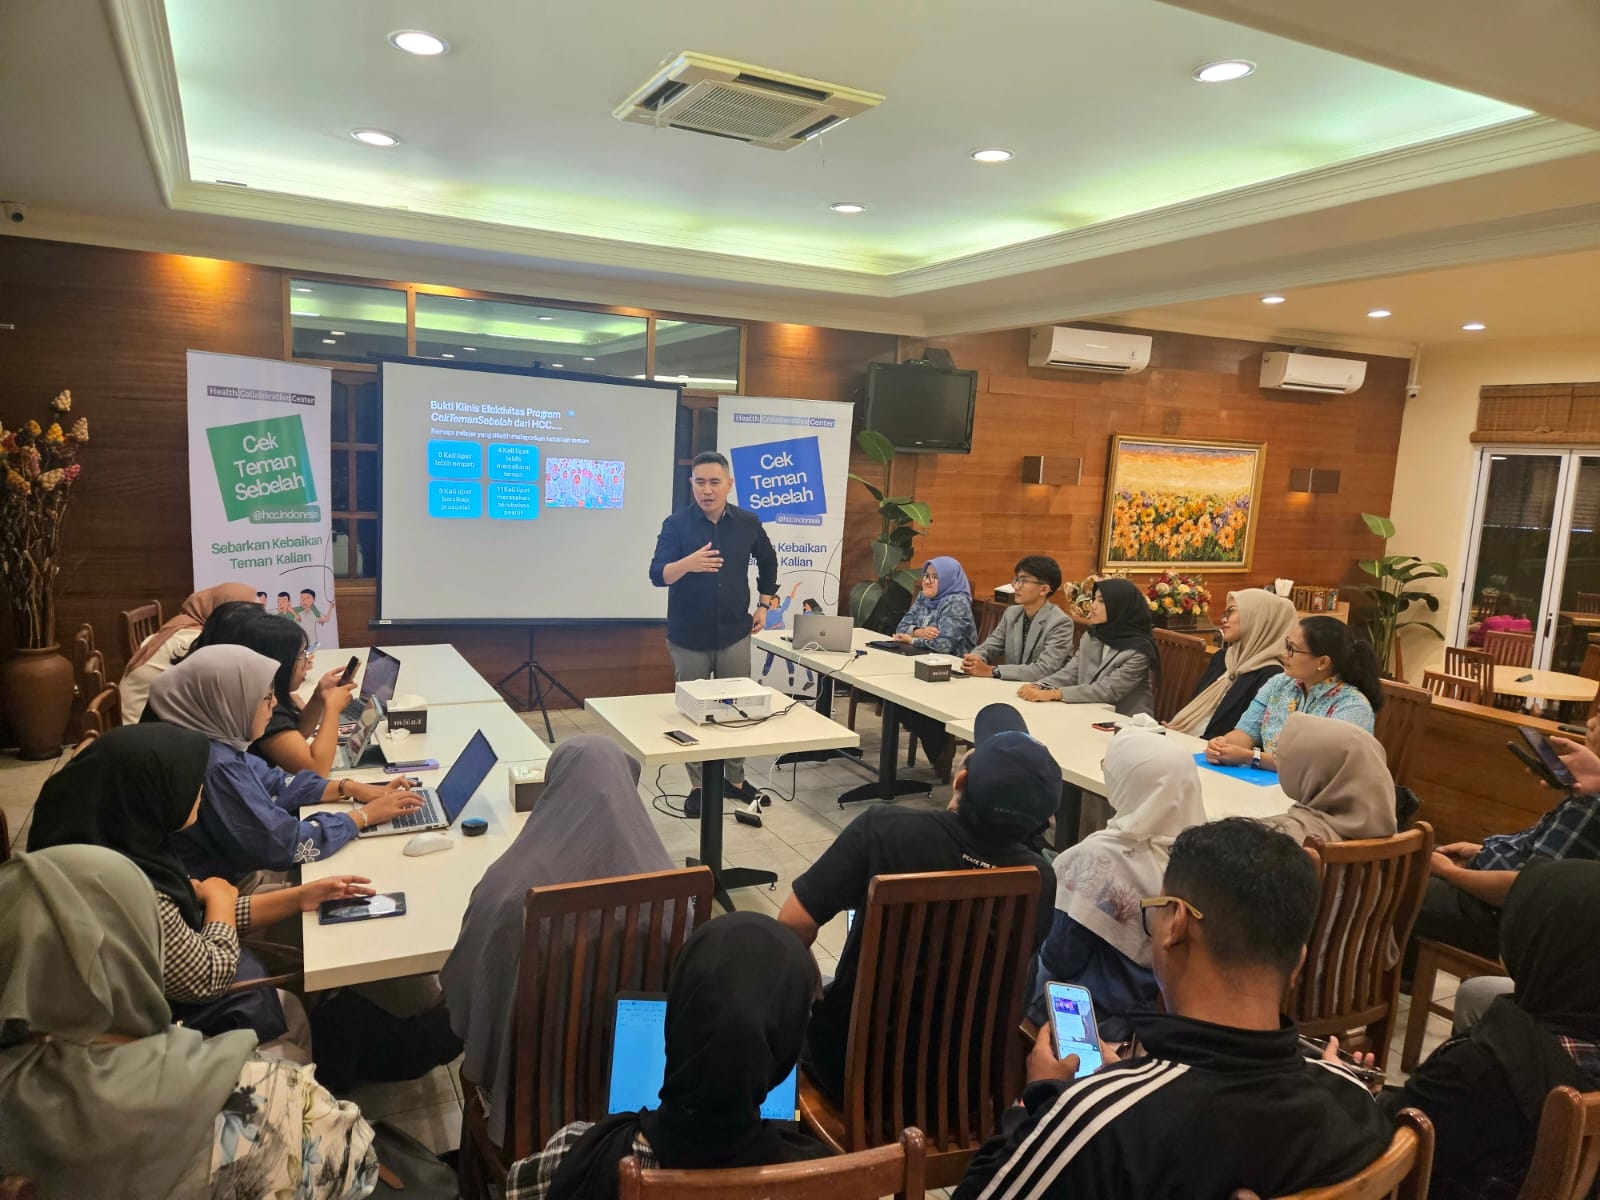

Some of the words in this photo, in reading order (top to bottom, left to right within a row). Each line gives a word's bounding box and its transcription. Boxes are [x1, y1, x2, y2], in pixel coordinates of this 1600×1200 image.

[209, 386, 238, 397] Health
[291, 394, 315, 404] Center
[430, 400, 454, 411] Bukti
[455, 402, 480, 413] Klinis
[481, 404, 525, 416] Efektivitas
[526, 408, 561, 419] Program
[514, 418, 531, 428] dari
[735, 414, 760, 423] Health
[809, 418, 834, 427] Center
[242, 431, 279, 453] Cek
[233, 455, 297, 478] Teman
[760, 451, 794, 470] Cek
[235, 472, 305, 501] Sebelah
[750, 471, 807, 490] Teman
[750, 486, 814, 509] Sebelah
[211, 540, 270, 555] Sebarkan
[272, 535, 322, 549] Kebaikan
[778, 542, 827, 553] Kebaikan
[230, 556, 273, 570] Teman
[276, 552, 312, 565] Kalian
[780, 556, 813, 567] Kalian
